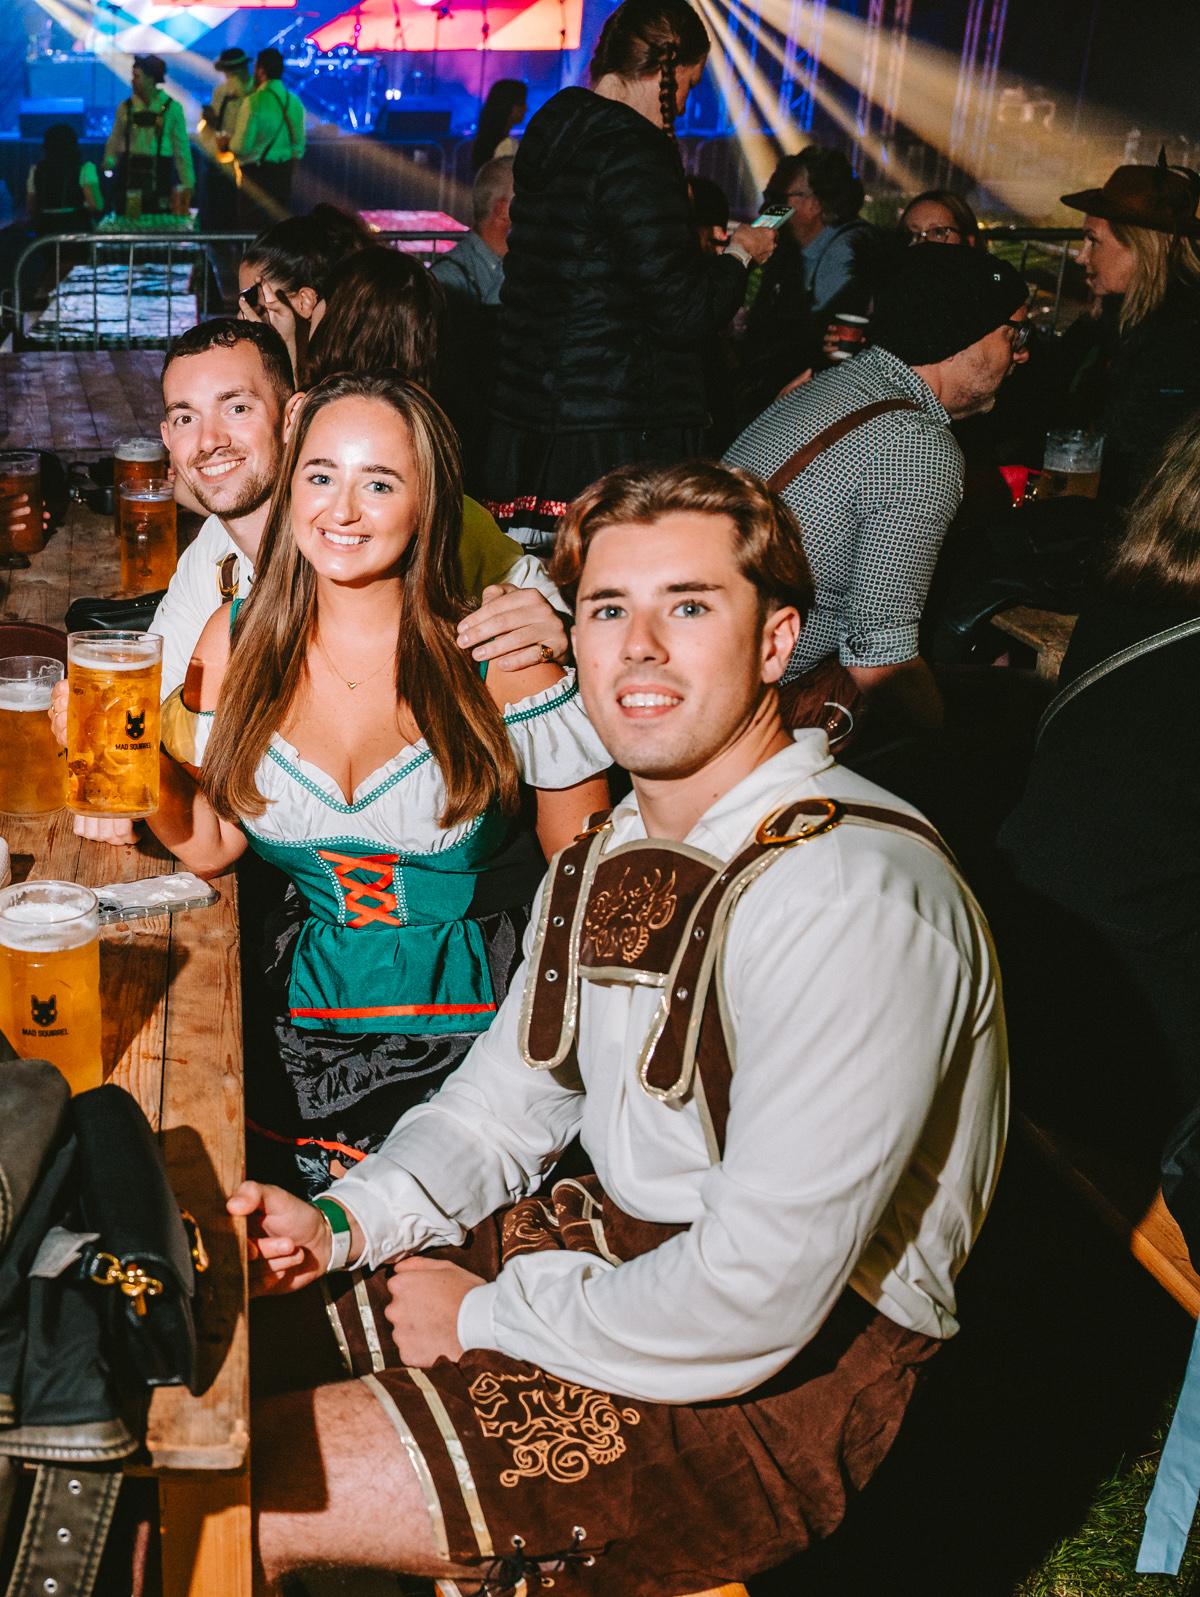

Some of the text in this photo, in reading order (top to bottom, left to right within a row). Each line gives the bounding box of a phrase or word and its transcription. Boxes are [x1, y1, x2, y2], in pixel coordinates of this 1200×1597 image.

[130, 742, 151, 750] SQUIRREL
[22, 1028, 68, 1037] MAD SQUIRREL
